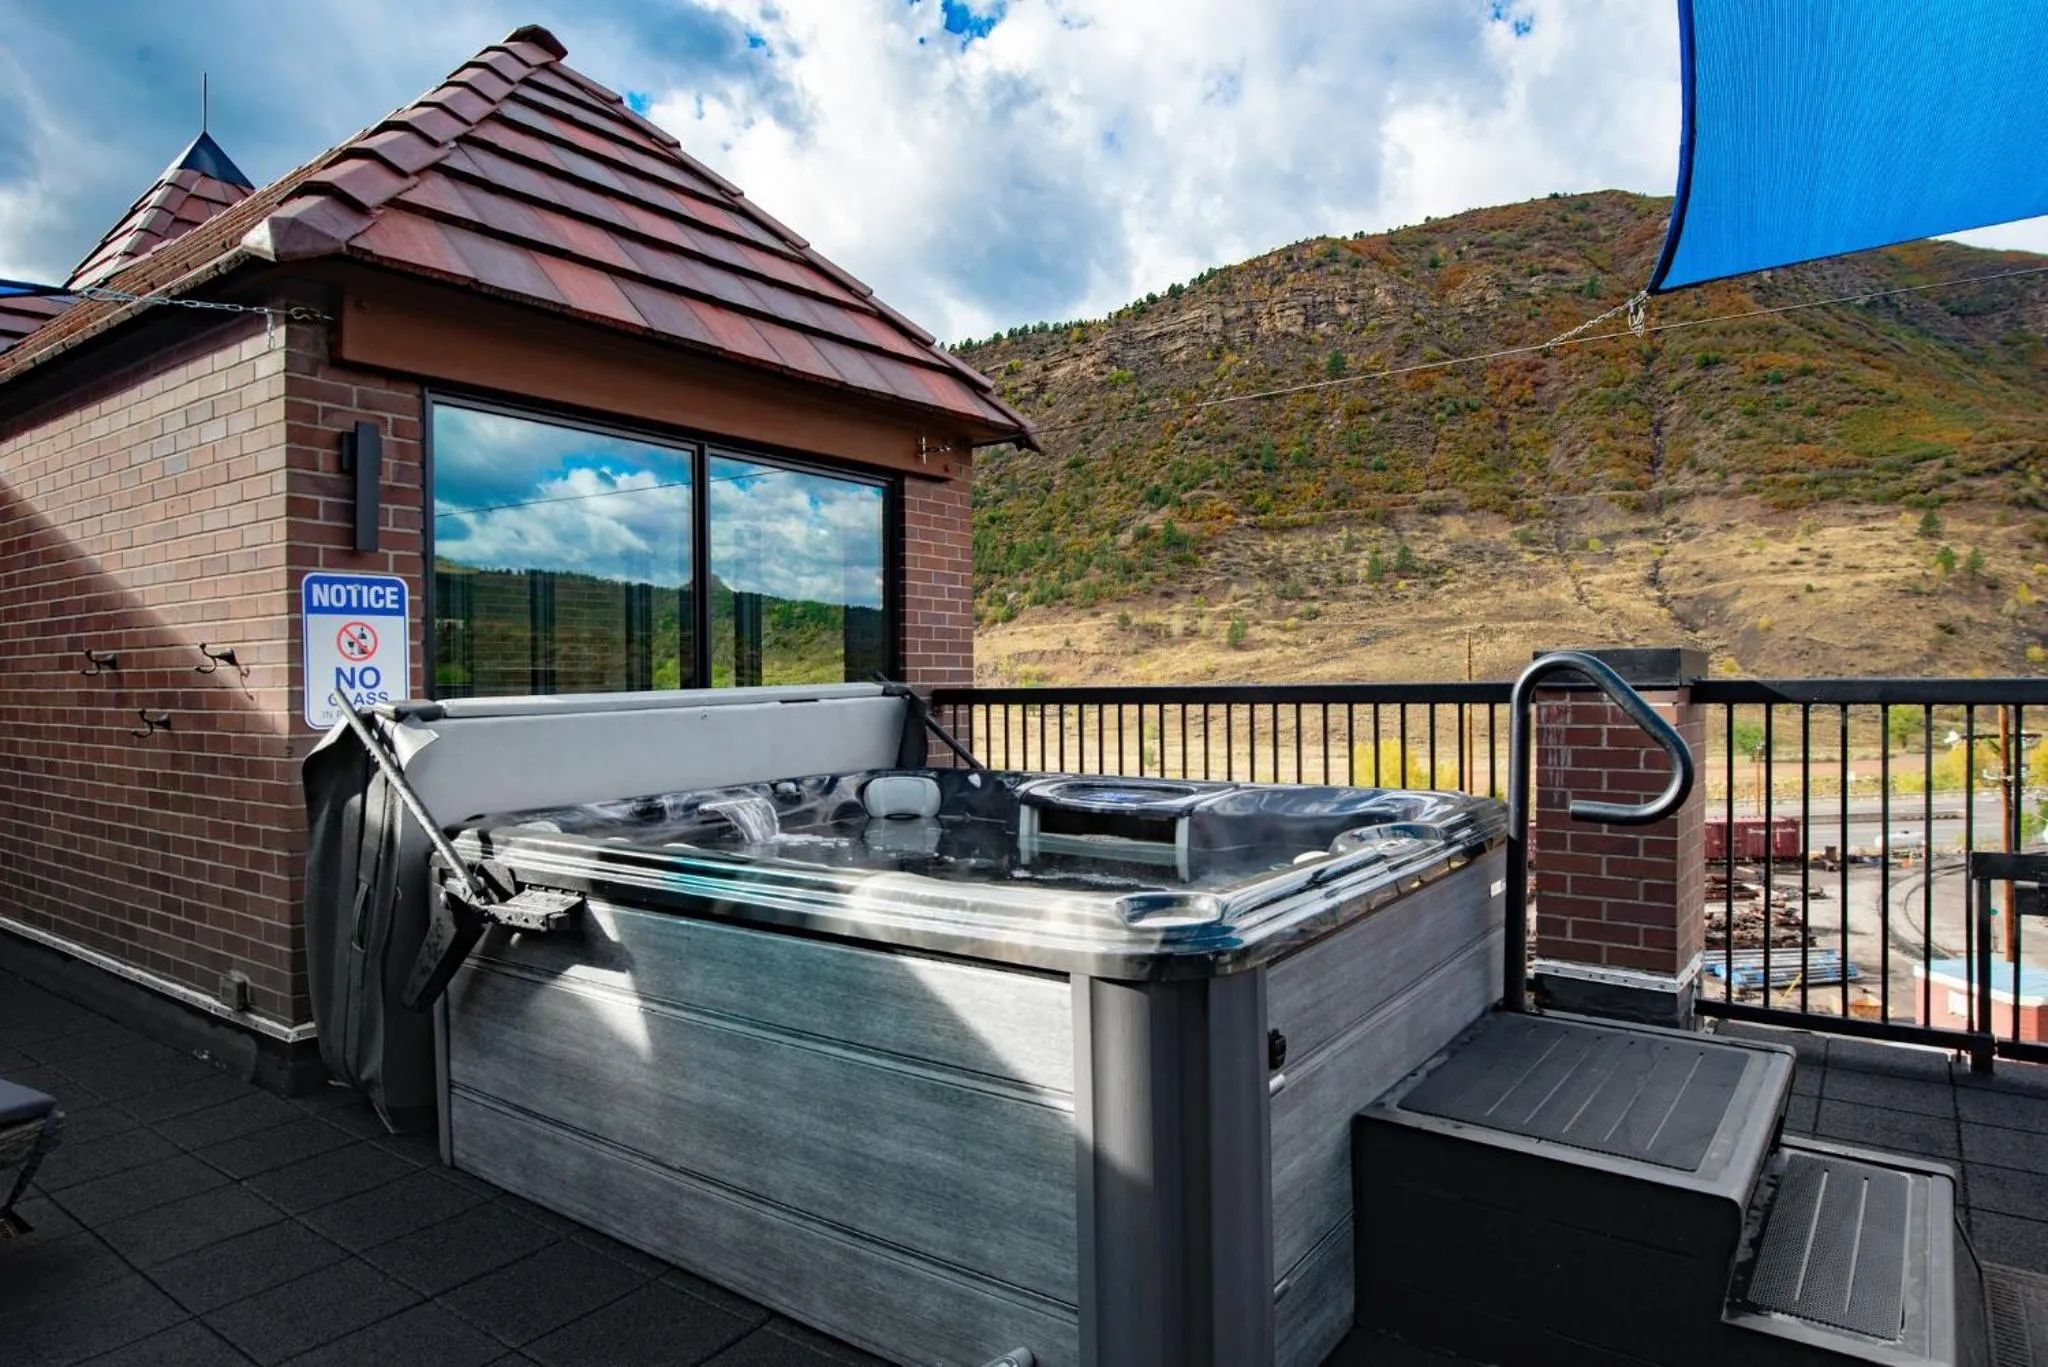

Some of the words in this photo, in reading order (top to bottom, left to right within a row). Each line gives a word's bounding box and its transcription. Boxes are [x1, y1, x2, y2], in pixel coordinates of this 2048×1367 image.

[312, 583, 400, 609] NOTICE
[335, 666, 381, 690] NO
[328, 691, 389, 707] GASS
